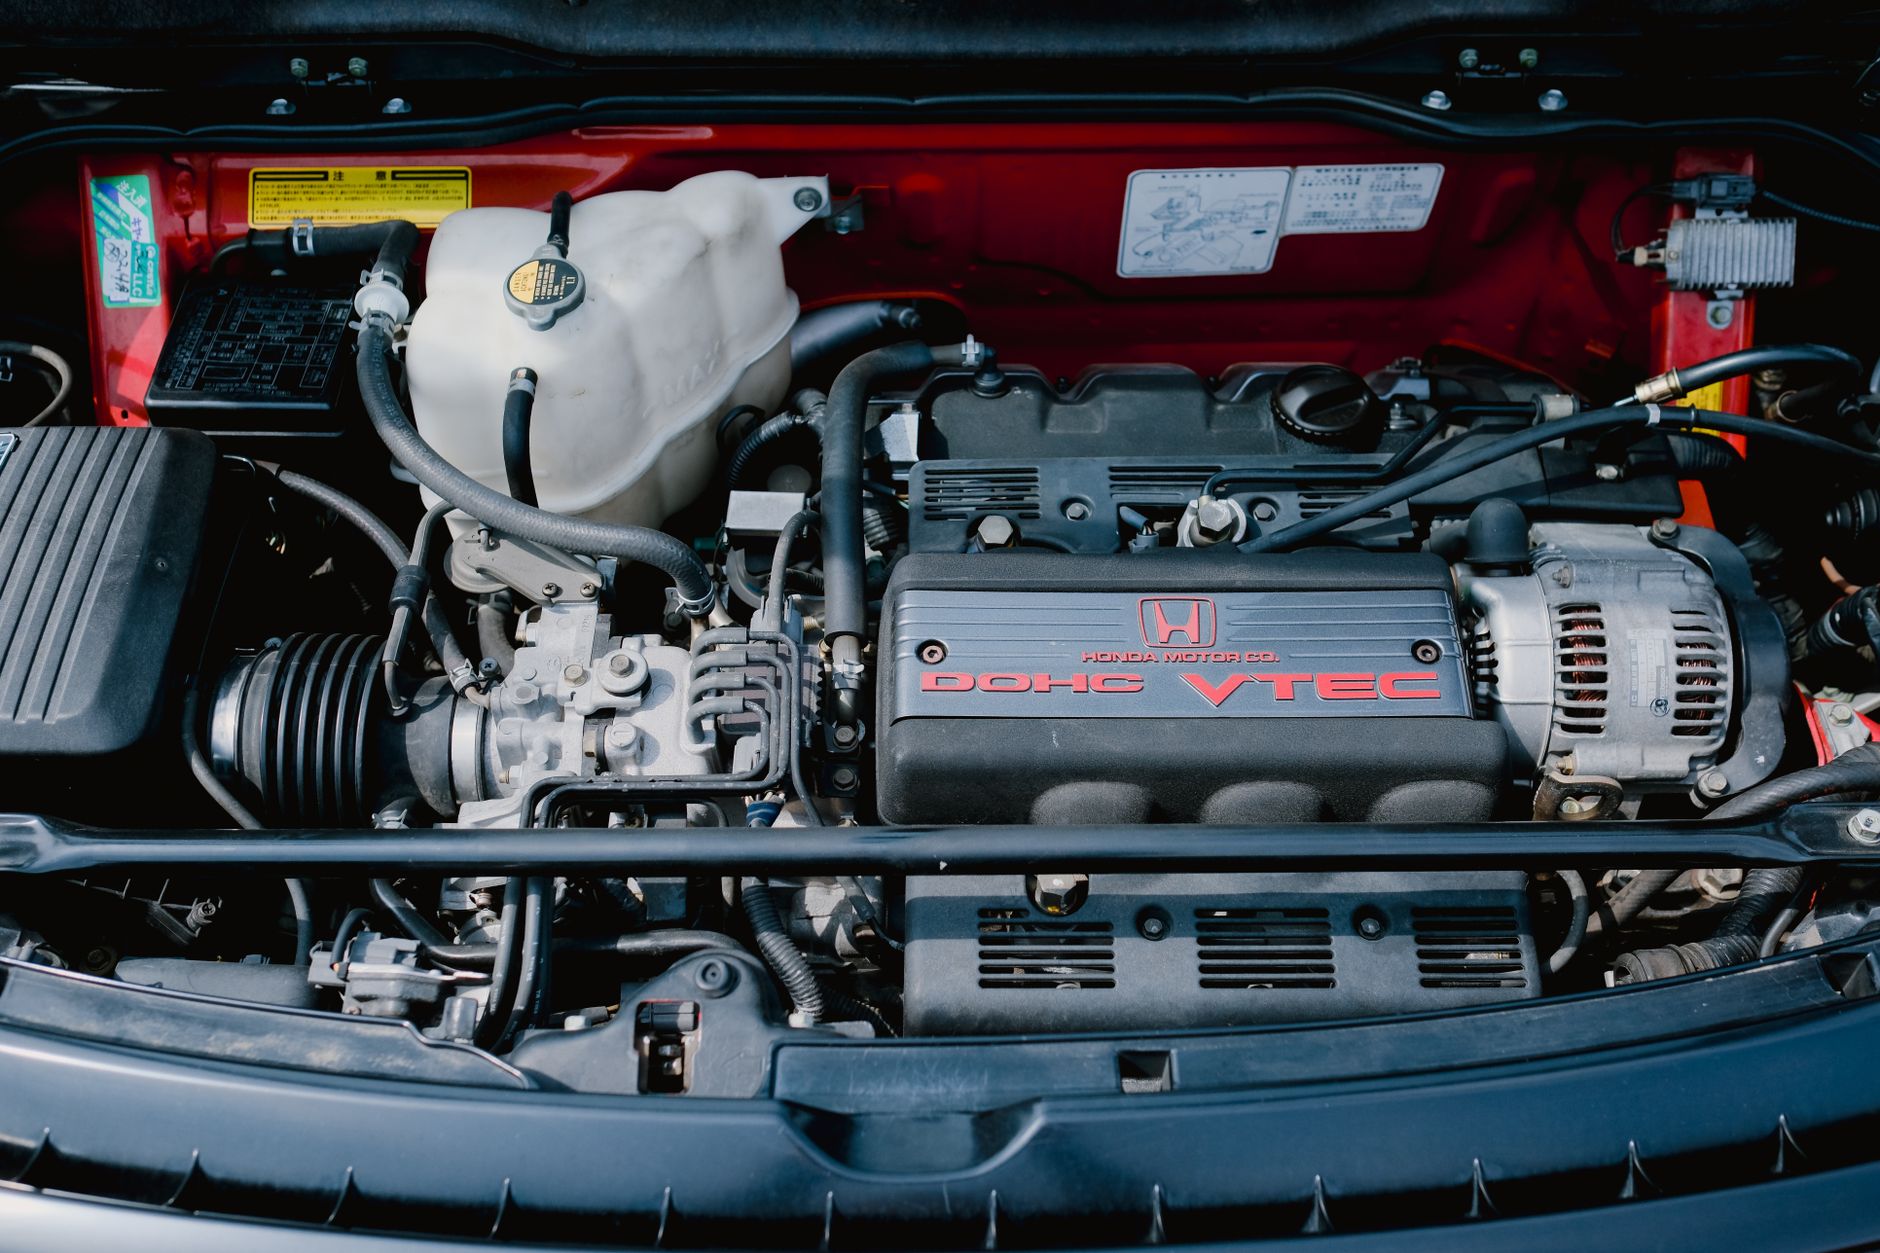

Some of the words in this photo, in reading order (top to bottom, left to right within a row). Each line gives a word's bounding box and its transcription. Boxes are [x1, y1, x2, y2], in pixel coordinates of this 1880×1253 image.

[1081, 651, 1159, 663] HONDA
[1163, 651, 1242, 663] MOTOR
[1245, 651, 1281, 663] CO.
[920, 672, 1144, 693] DOHC
[1178, 671, 1441, 708] VTEC
